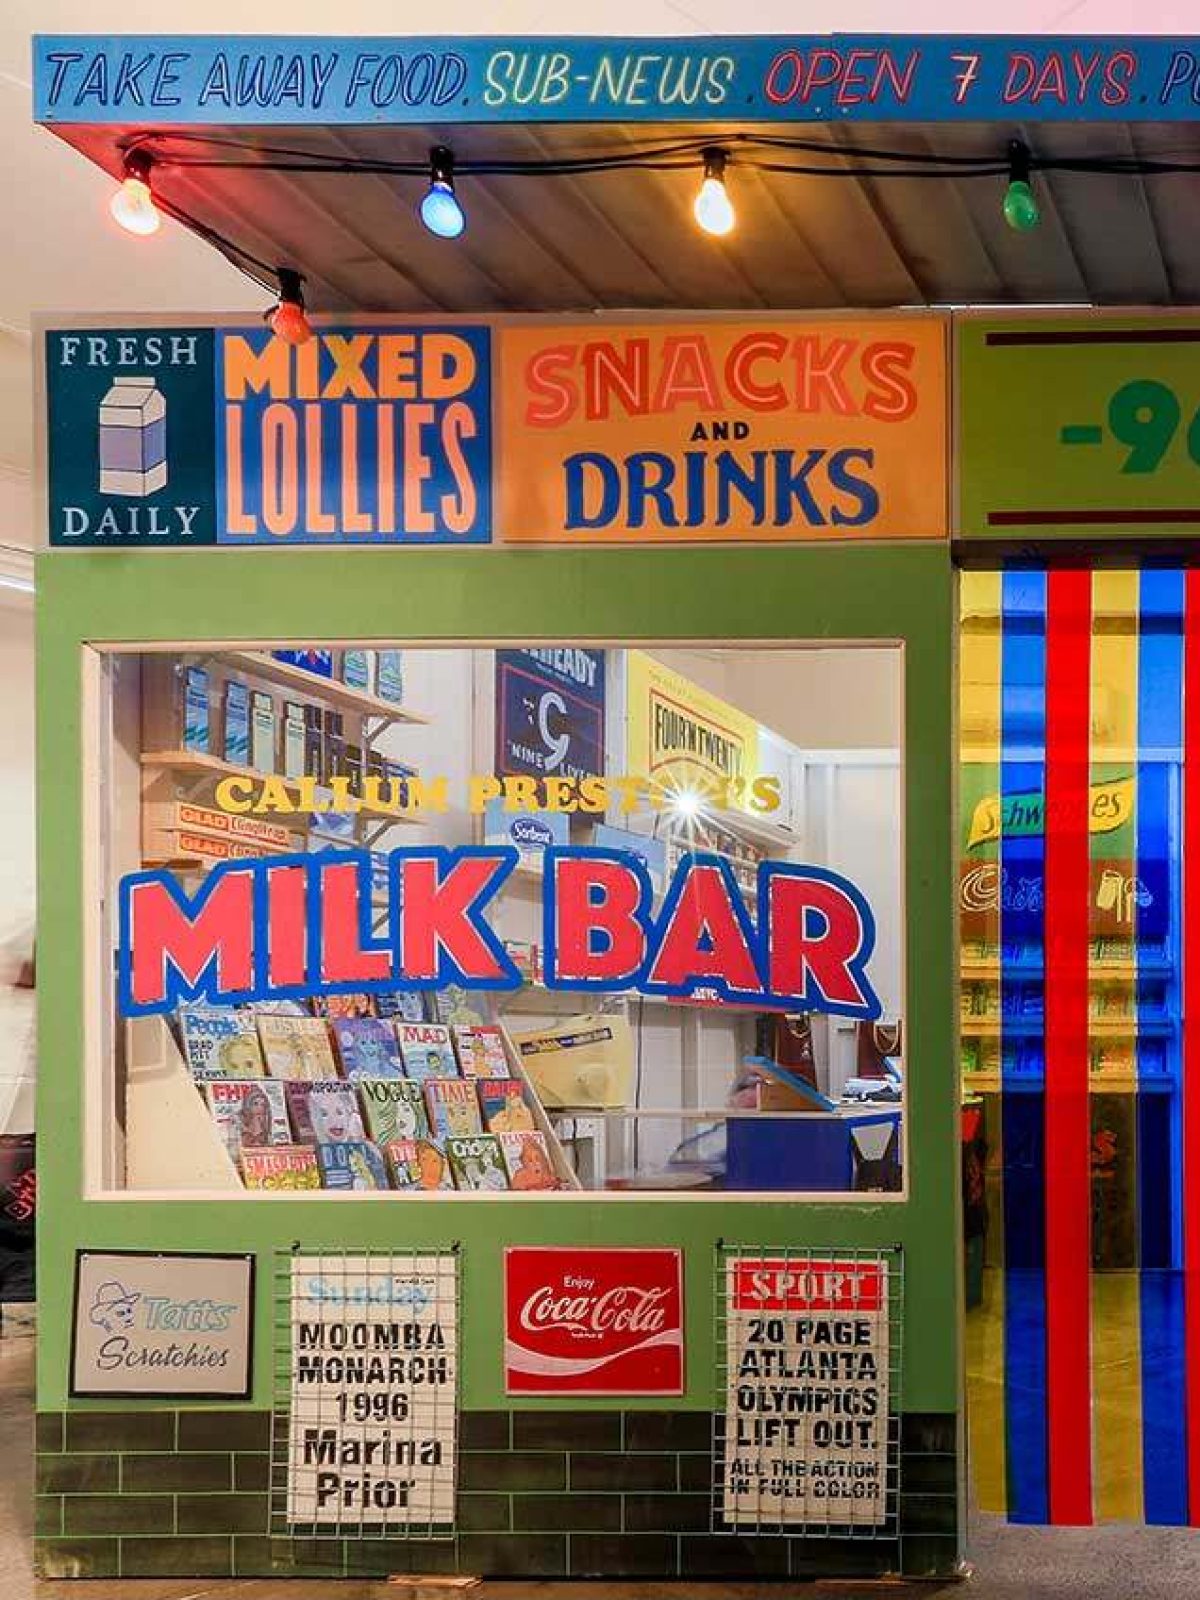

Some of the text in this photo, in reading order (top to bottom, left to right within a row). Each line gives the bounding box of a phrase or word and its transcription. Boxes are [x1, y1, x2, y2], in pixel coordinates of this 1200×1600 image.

[47, 52, 190, 107] TAKE
[200, 52, 338, 108] AWAY
[763, 49, 920, 104] OPEN
[950, 55, 982, 104] 7
[59, 336, 198, 366] FRESH
[223, 333, 477, 400] MIXED
[524, 330, 919, 430] SNACKS
[690, 421, 751, 442] AND
[224, 401, 477, 536] LOLLIES
[562, 448, 880, 530] DRINKS
[61, 507, 201, 537] DAILY
[216, 775, 448, 814] CALLUM
[119, 846, 884, 1021] MILK BAR
[403, 1026, 449, 1044] MAD
[362, 1080, 422, 1102] VOGUE
[427, 1080, 477, 1102] TIME
[307, 1275, 435, 1315] Sunday
[563, 1275, 596, 1291] Enjoy
[751, 1271, 867, 1302] SPORT
[143, 1297, 240, 1332] Tatts
[520, 1286, 672, 1333] Coca-Cola
[299, 1322, 445, 1350] MOOMBA
[747, 1319, 871, 1346] 20 PAGE
[96, 1335, 229, 1371] Scratchies
[738, 1351, 878, 1380] ATLANTA
[298, 1356, 447, 1384] MONARCH
[335, 1391, 409, 1423] 1996
[737, 1384, 878, 1416] OLYMPICS
[303, 1428, 442, 1466] Marina
[735, 1419, 801, 1449] LIFT
[730, 1458, 880, 1479] ALL THE ACTION
[316, 1472, 417, 1508] Prior
[729, 1477, 880, 1499] IN FULL COLOR
